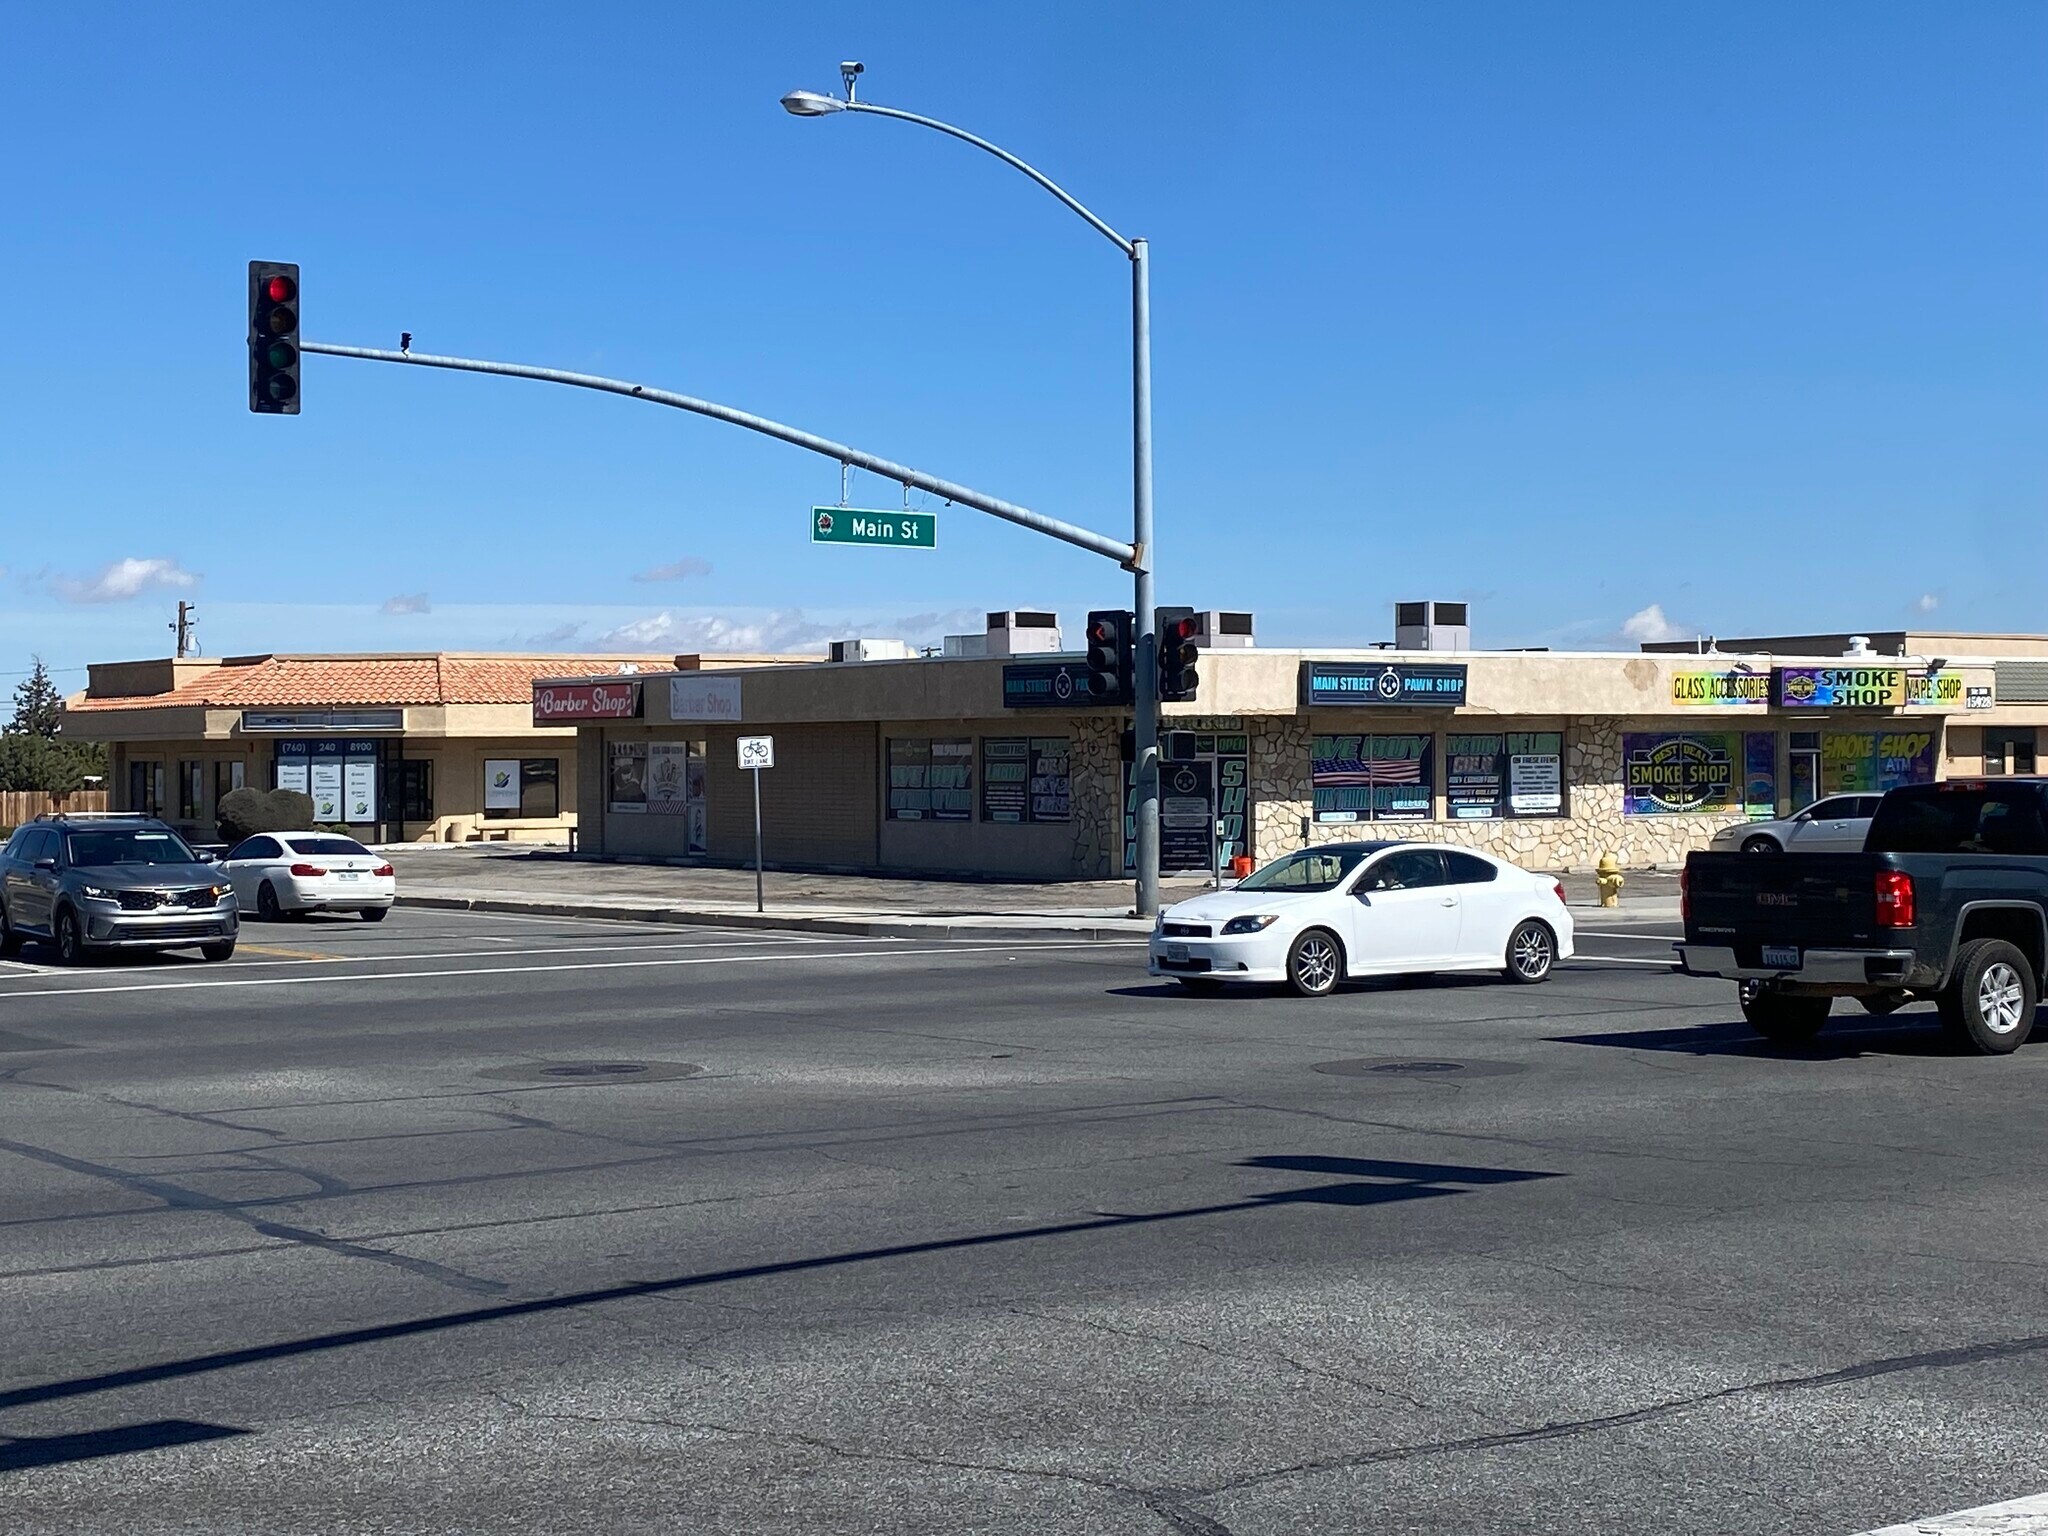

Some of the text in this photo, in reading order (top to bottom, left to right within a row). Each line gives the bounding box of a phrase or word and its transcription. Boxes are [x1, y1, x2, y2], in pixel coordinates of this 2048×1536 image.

[852, 518, 919, 539] Main St
[1006, 679, 1024, 693] MAIN
[1026, 679, 1052, 693] STREET
[1313, 677, 1464, 692] MAIN STREET PAWN SHOP
[1674, 677, 1771, 699] GLASS ACCESSORIES
[1821, 671, 1899, 687] SMOKE
[1832, 690, 1892, 705] SHOP
[1906, 679, 1962, 699] VAPE SHOP
[541, 687, 626, 717] Barber Shop
[673, 692, 732, 717] Barber Shop
[282, 742, 373, 753] (760) 240 8900
[1219, 737, 1246, 752] OPEN
[1311, 736, 1431, 760] WE BUY
[1823, 734, 1931, 759] SMOKE SHOP
[1653, 745, 1708, 764] BEST DEAL
[1631, 766, 1681, 784] SMOKE
[1690, 765, 1728, 783] SHOP
[1885, 758, 1911, 772] ATM
[1220, 760, 1247, 867] SHOP
[1756, 893, 1798, 906] GMC
